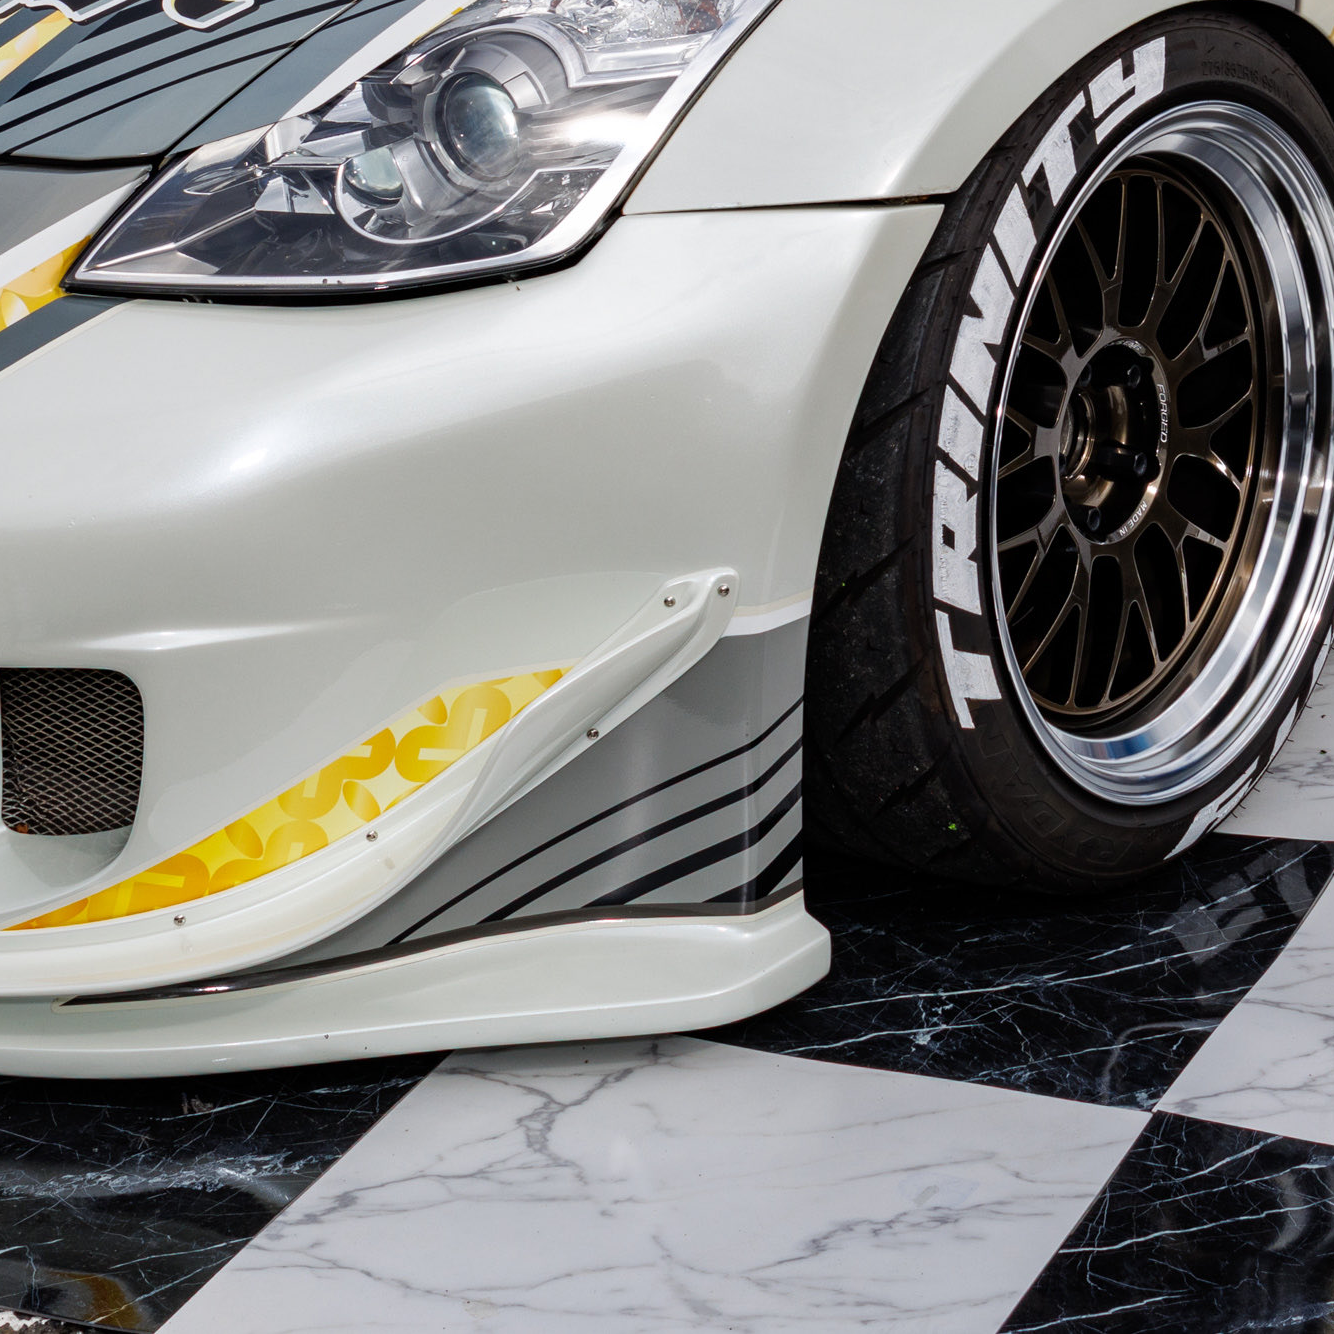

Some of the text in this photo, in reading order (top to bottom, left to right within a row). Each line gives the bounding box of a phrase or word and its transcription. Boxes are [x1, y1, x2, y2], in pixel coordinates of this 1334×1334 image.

[932, 36, 1166, 730] TRINITY
[1157, 383, 1169, 443] FORGED
[1128, 500, 1148, 530] MADE
